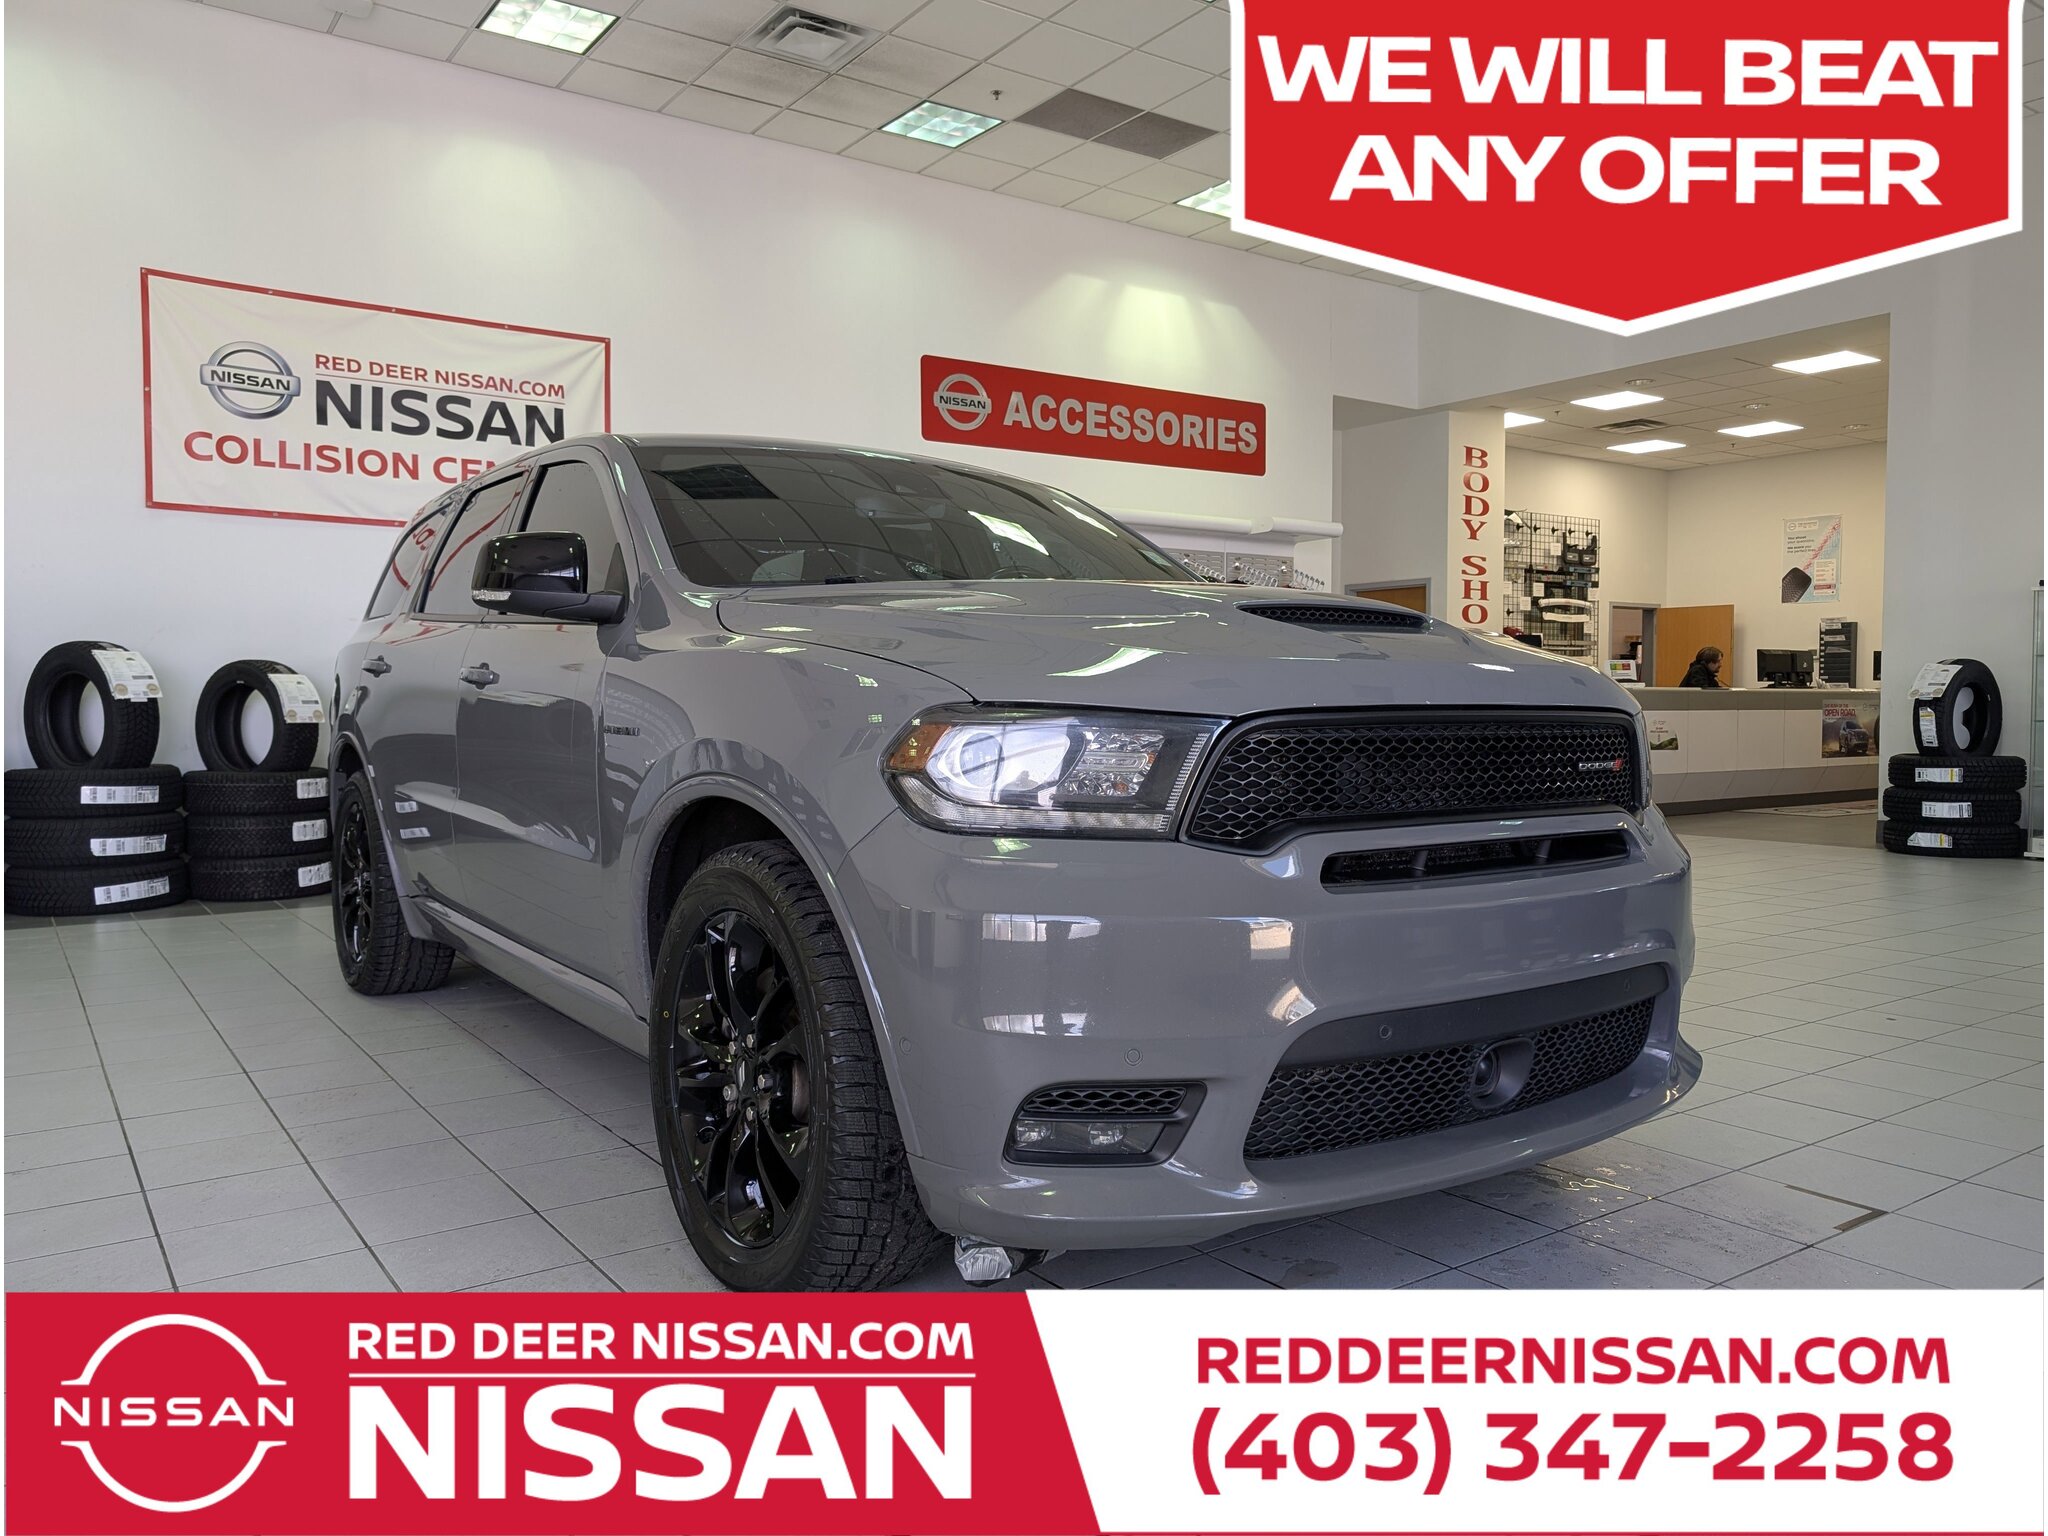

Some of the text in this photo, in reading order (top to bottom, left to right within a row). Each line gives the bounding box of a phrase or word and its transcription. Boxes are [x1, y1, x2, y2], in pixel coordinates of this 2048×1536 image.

[210, 369, 291, 391] NISSAN
[315, 354, 565, 399] RED DEER NISSAN.COM
[315, 379, 565, 447] NISSAN
[939, 395, 986, 409] NISSAN
[1003, 391, 1258, 454] ACCESSORIES
[184, 431, 498, 484] COLLISION CE
[1462, 446, 1490, 541] BODY
[1824, 709, 1840, 717] OPEN
[1579, 761, 1617, 770] DODGE
